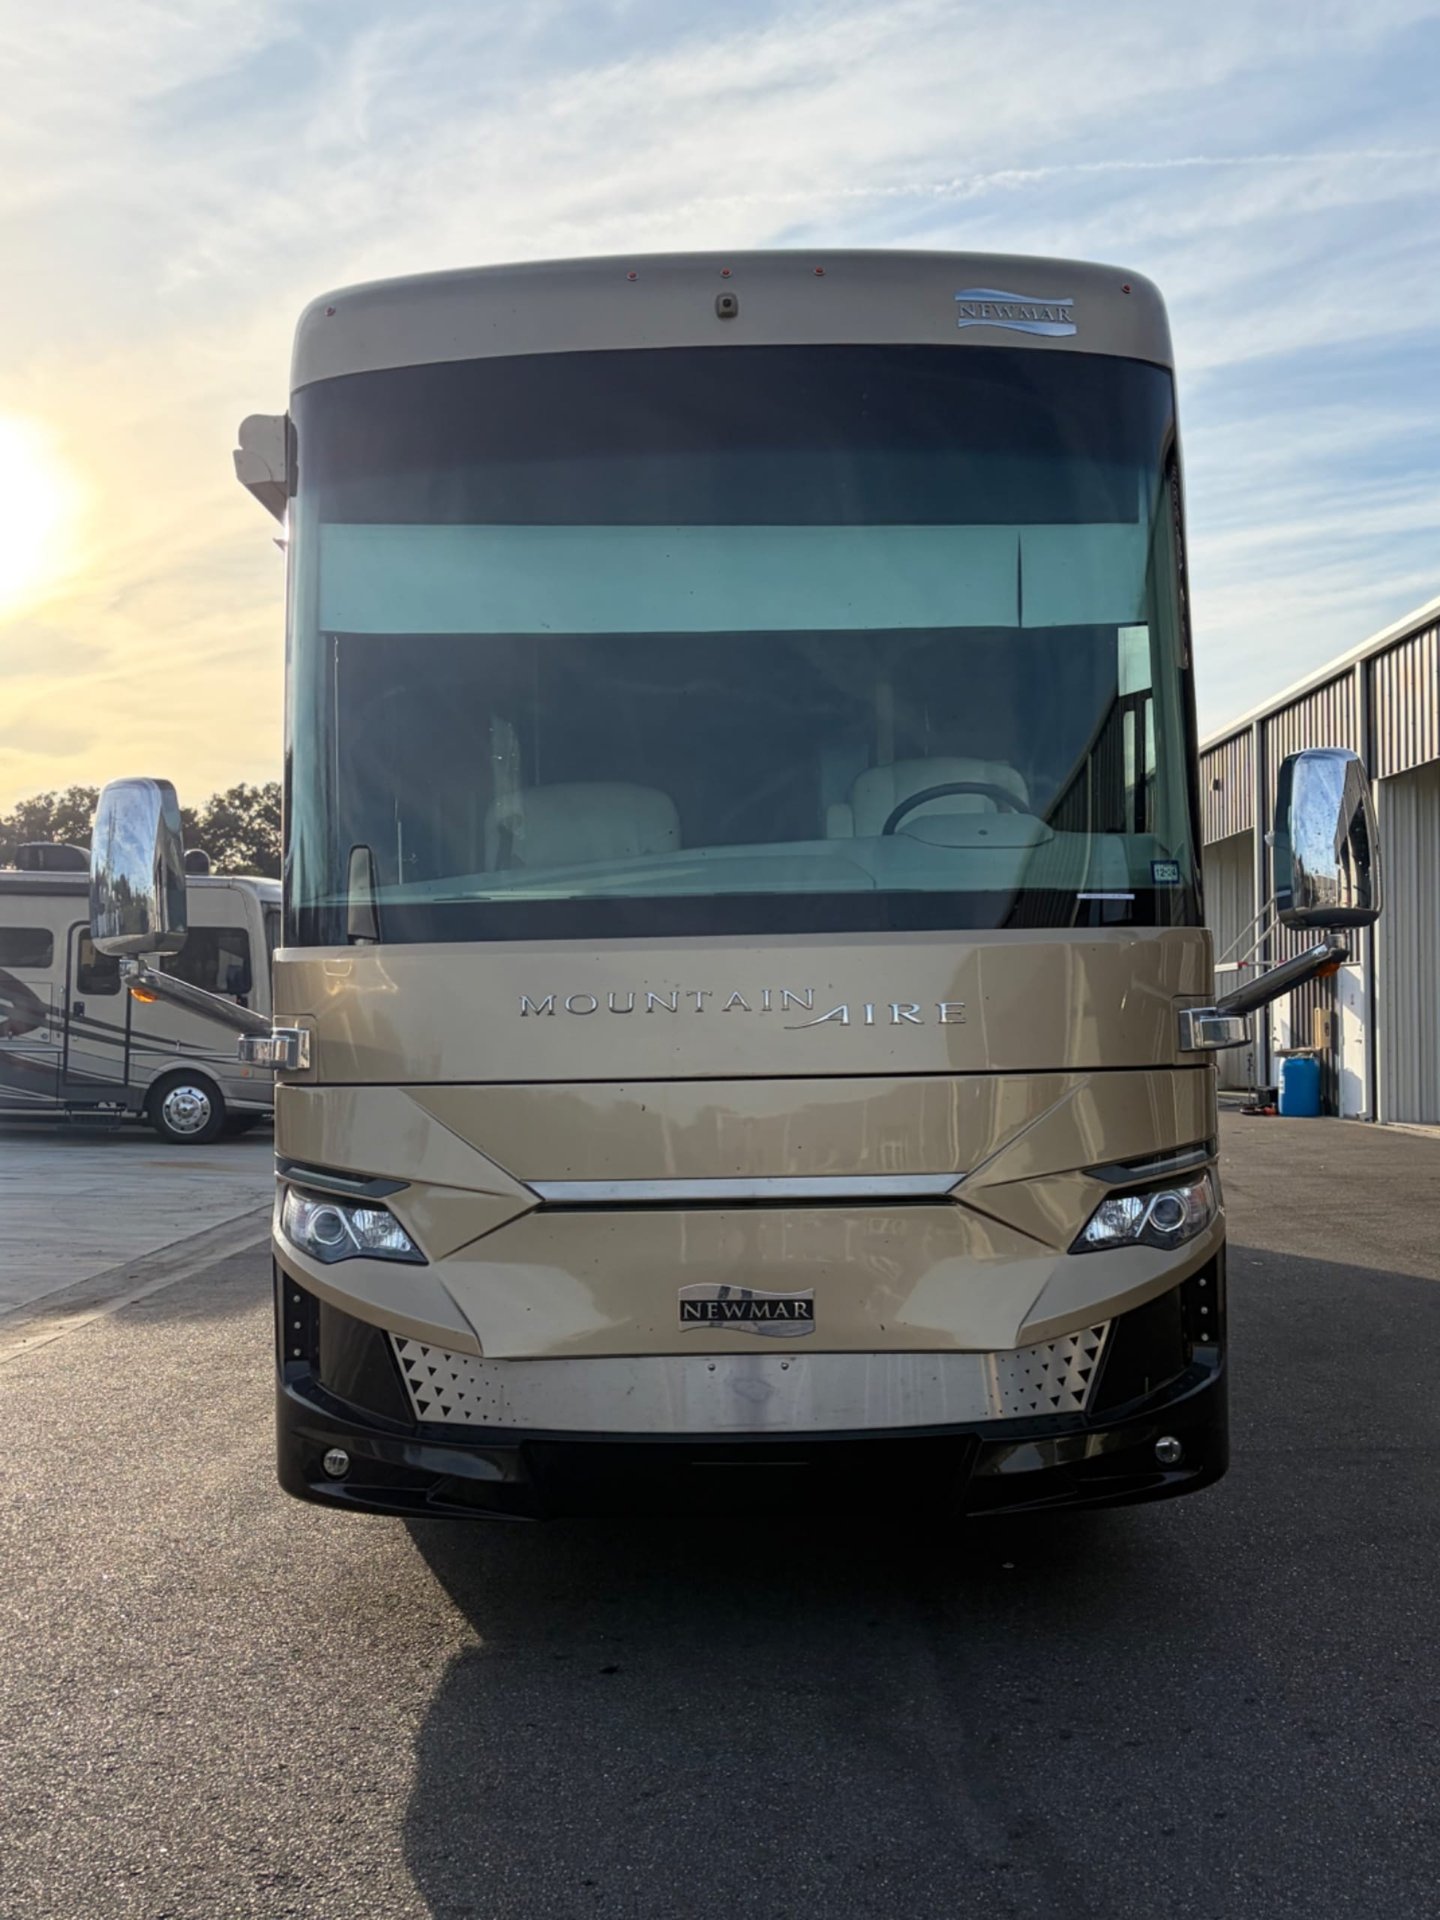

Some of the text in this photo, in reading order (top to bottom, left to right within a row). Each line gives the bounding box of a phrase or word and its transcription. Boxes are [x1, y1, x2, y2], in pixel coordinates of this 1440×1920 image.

[958, 303, 1072, 322] NEWMAR
[519, 988, 966, 1029] MOUNTAIN AIRE
[683, 1302, 811, 1319] NEWMAR
